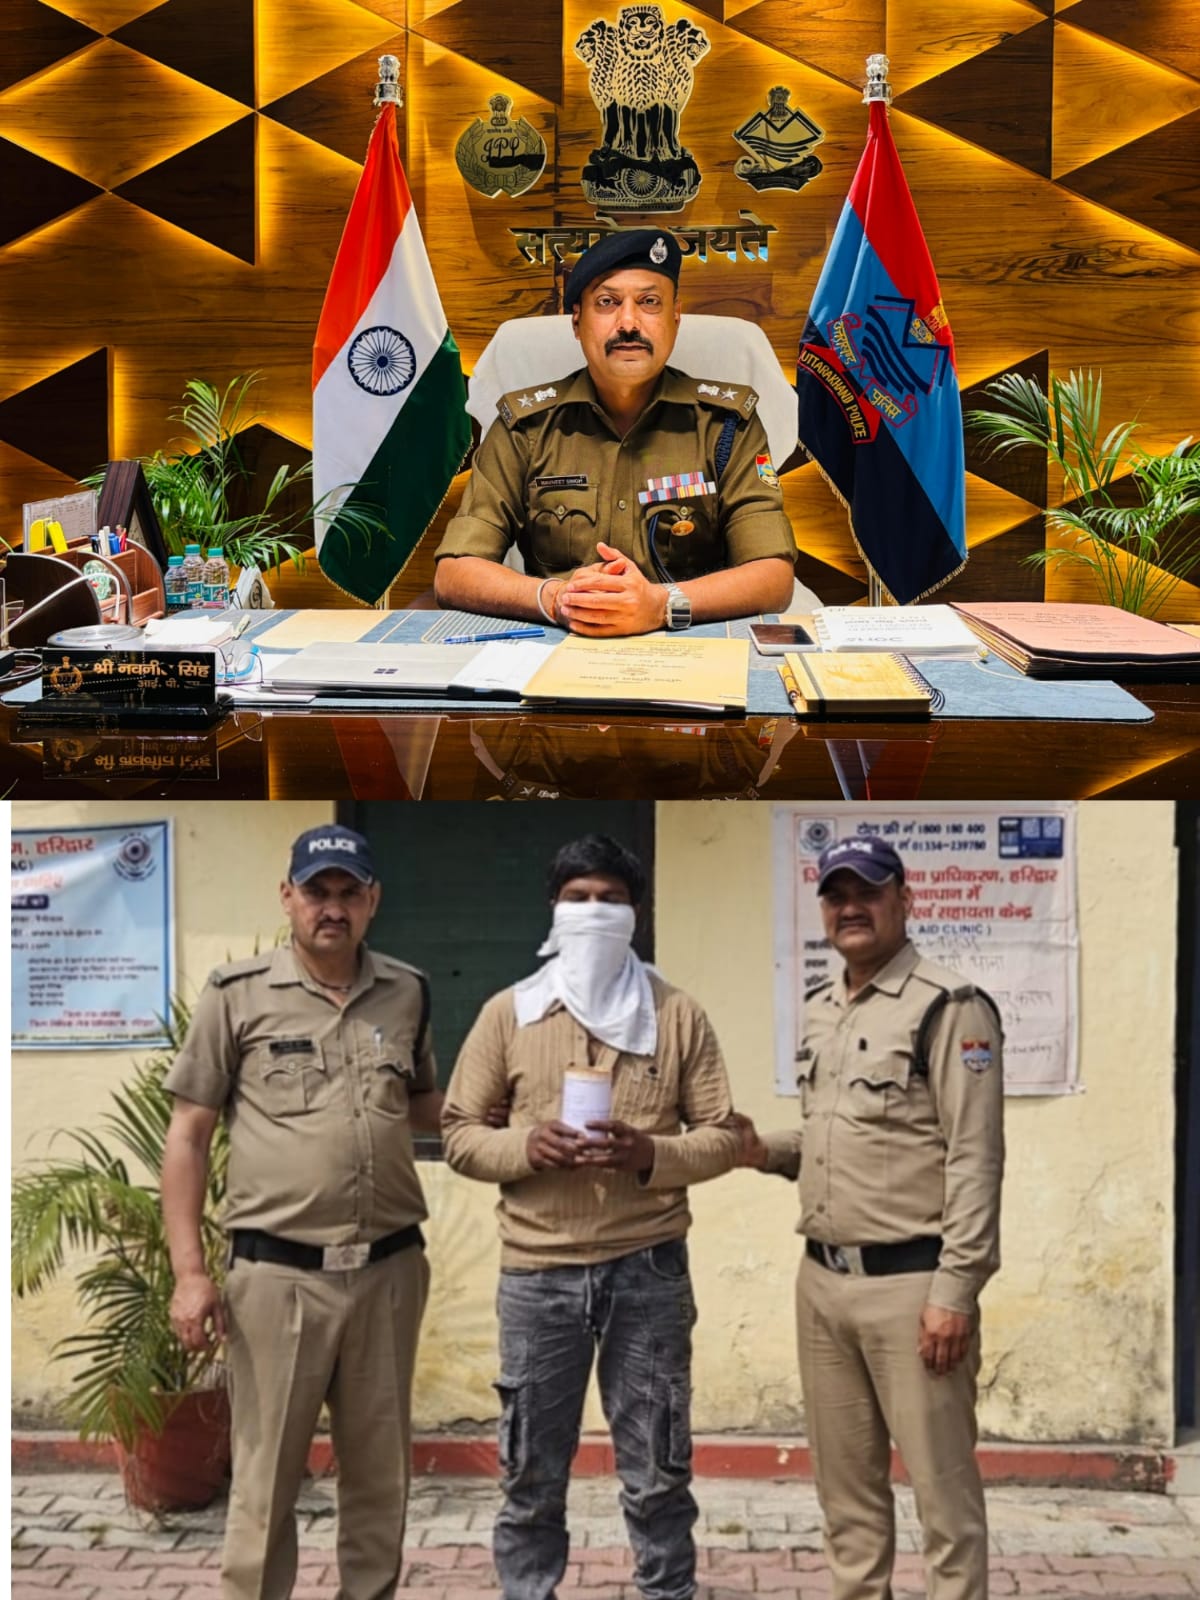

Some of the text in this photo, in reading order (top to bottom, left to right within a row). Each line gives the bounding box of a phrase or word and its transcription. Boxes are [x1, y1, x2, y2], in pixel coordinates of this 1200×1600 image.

[800, 350, 867, 439] UTTARAKHAND POLICE
[871, 388, 902, 420] पुलिस
[93, 658, 113, 675] श्री
[178, 660, 211, 678] सिंह
[308, 838, 357, 854] POLICE
[1009, 865, 1058, 884] हरिद्वार
[938, 906, 994, 920] सहायता
[918, 924, 940, 935] AID
